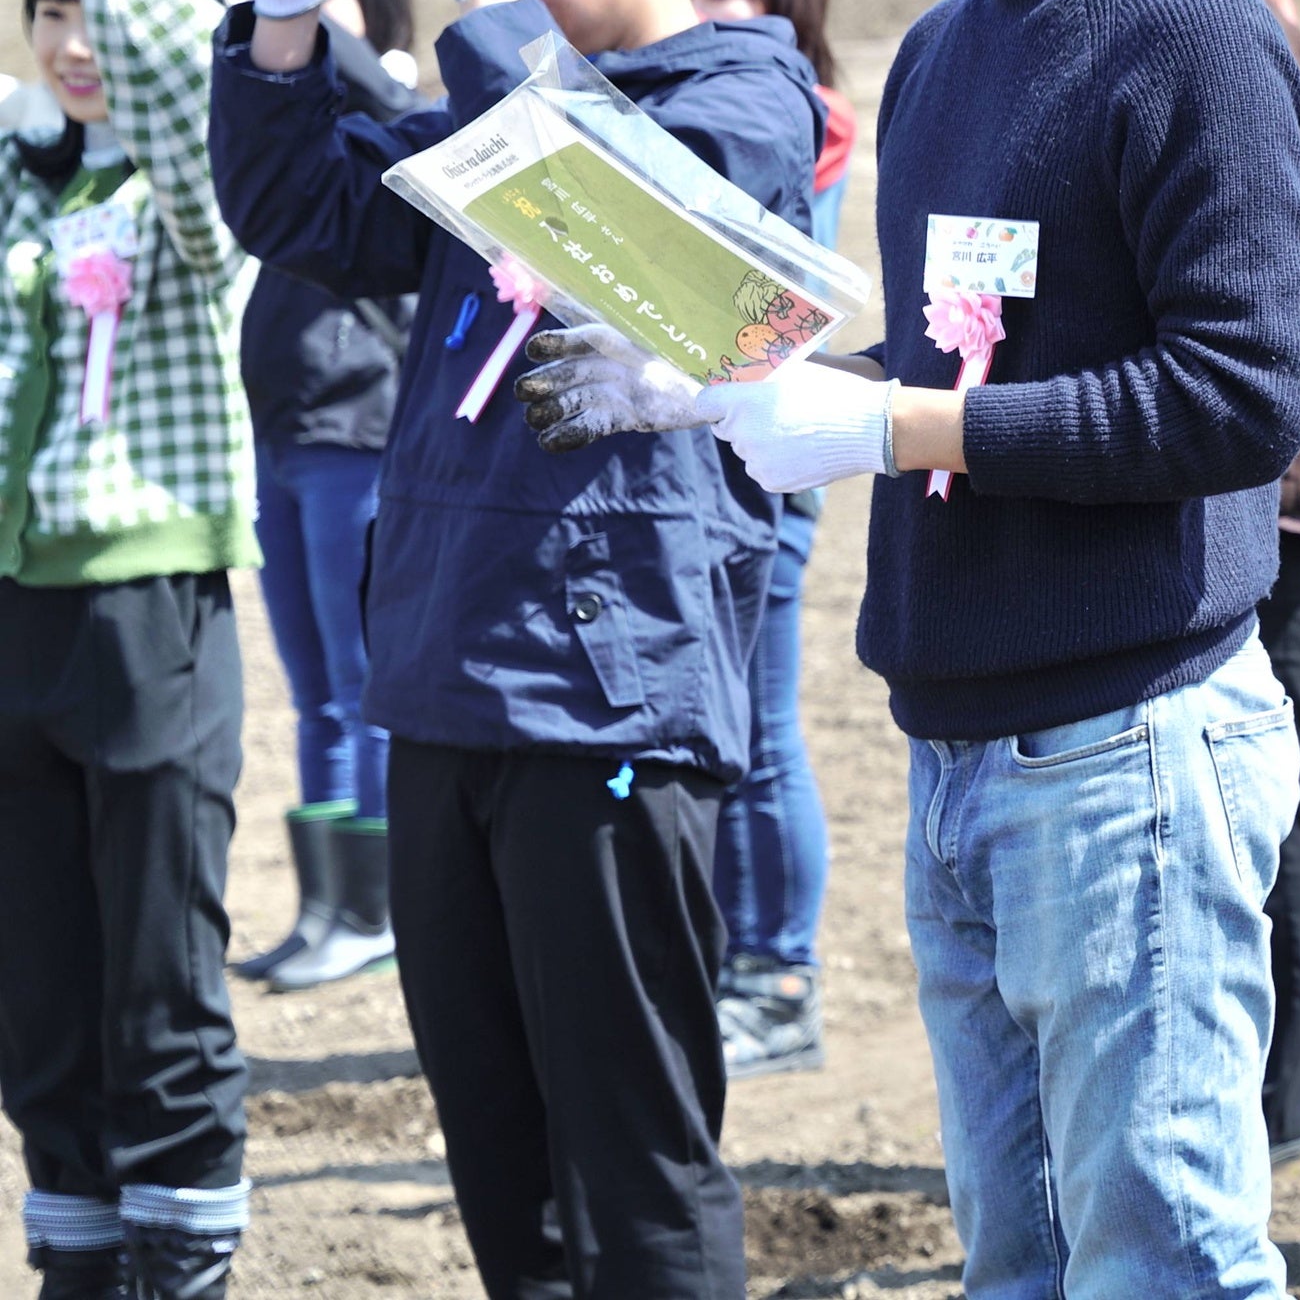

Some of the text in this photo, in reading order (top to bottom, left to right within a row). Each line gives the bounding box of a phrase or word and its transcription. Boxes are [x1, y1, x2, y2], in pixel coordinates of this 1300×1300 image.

[466, 157, 480, 172] ra
[476, 133, 509, 167] daichi
[601, 225, 624, 246] さん
[952, 251, 972, 262] 宮川
[538, 219, 707, 361] 入社おめでとう
